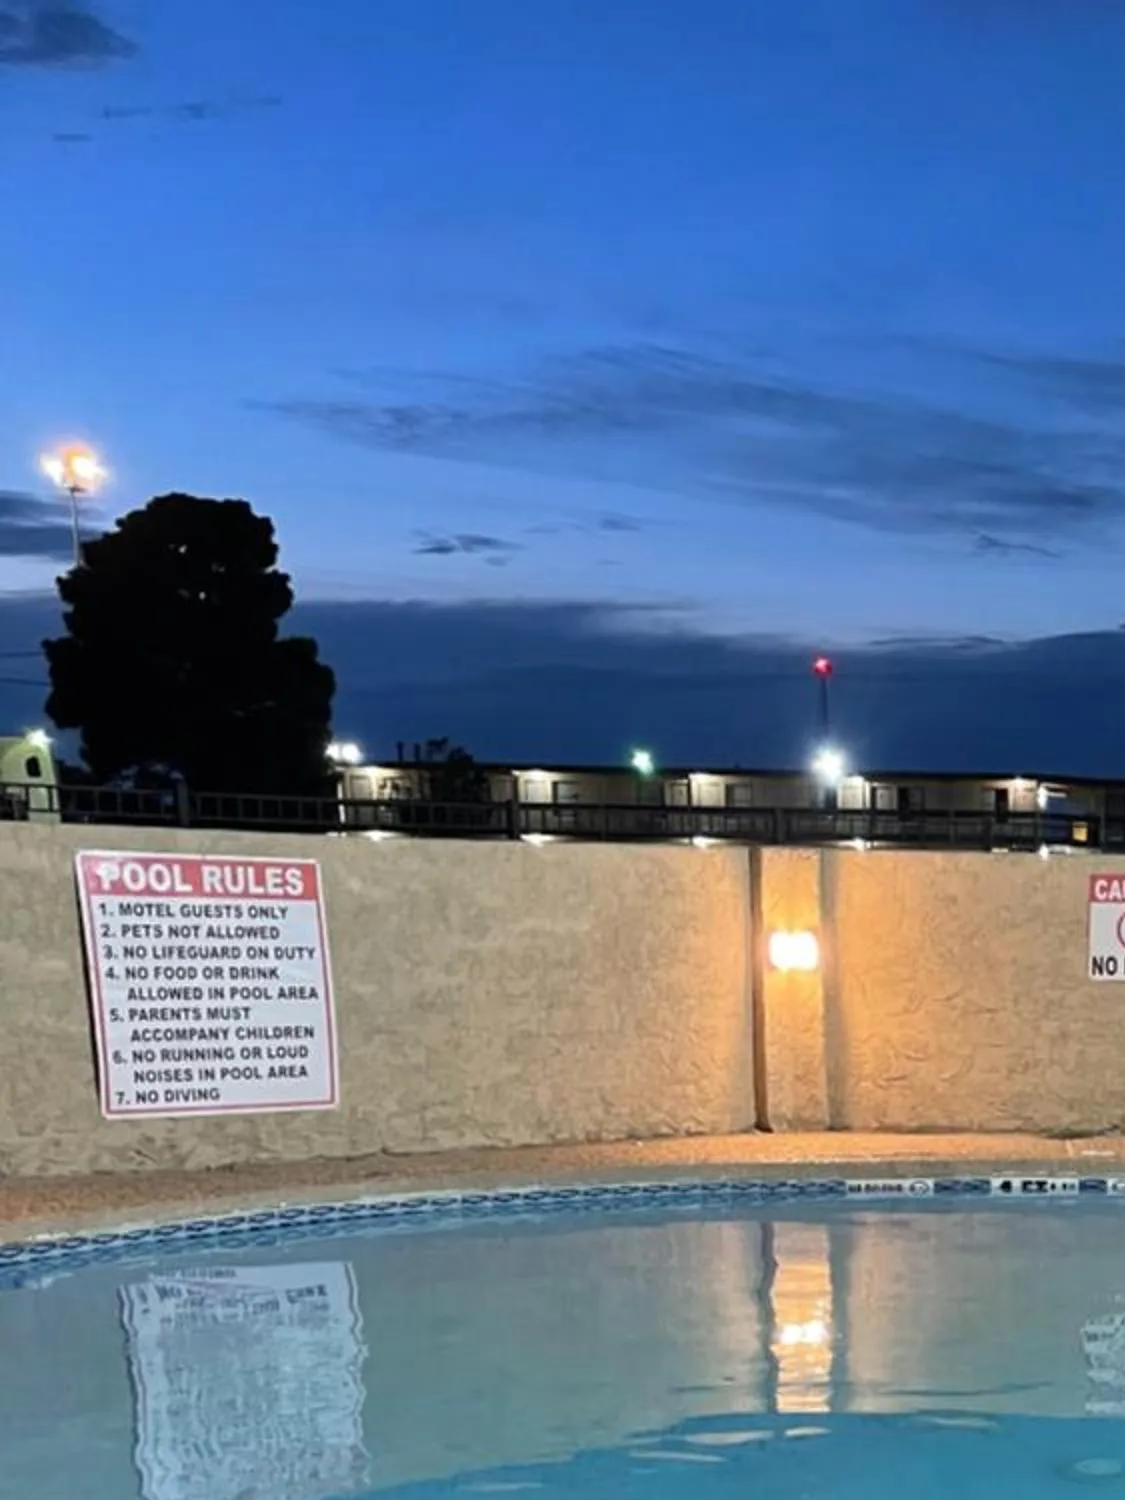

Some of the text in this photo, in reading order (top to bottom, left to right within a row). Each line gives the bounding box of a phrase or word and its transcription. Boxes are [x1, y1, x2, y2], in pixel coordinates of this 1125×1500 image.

[96, 861, 304, 896] POOL RULES
[118, 903, 175, 918] MOTEL
[180, 904, 243, 919] GUESTS
[248, 905, 288, 920] ONLY
[121, 924, 163, 939] PETS
[168, 925, 200, 939] NOT
[206, 925, 281, 940] ALLOWED
[123, 945, 147, 959] NO
[151, 945, 241, 960] LIFEGUARD
[246, 945, 269, 960] ON
[274, 946, 316, 960] DUTY
[125, 966, 149, 980] NO
[154, 966, 198, 981] FOOD
[202, 966, 224, 980] OR
[229, 966, 280, 981] DRINK
[1091, 956, 1118, 976] NO
[127, 985, 319, 1001] ALLOWED IN POOL AREA
[128, 1007, 202, 1021] PARENTS
[206, 1006, 251, 1021] MUST
[130, 1025, 315, 1043] ACCOMPANY CHILDREN
[132, 1049, 156, 1063] NO
[160, 1047, 236, 1062] RUNNING
[240, 1046, 263, 1060] OR
[266, 1045, 309, 1060] LOUD
[133, 1064, 308, 1083] NOISES IN POOL AREA
[135, 1089, 159, 1104] NO
[164, 1087, 221, 1103] DIVING
